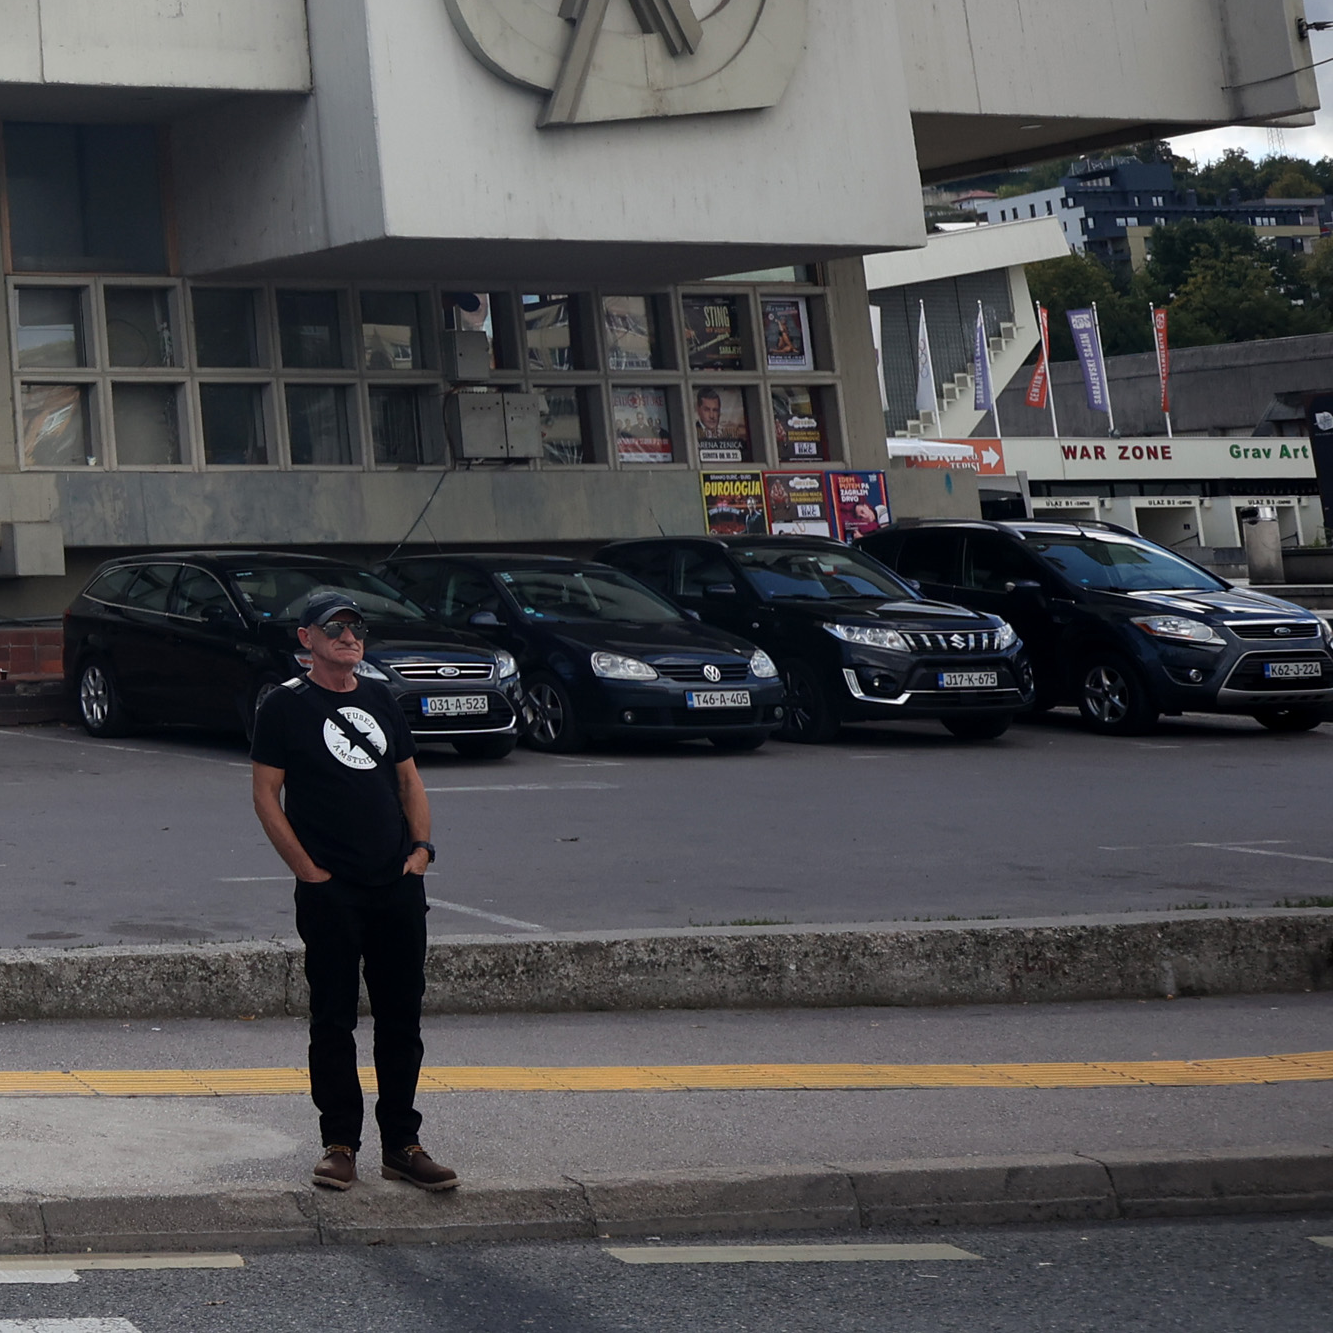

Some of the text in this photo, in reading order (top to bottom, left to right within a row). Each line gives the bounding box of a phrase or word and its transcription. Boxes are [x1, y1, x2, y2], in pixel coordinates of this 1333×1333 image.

[703, 306, 731, 328] STING
[1086, 358, 1103, 405] SARAJEVSKI
[1061, 445, 1173, 461] WAR ZONE
[1229, 444, 1310, 459] Grav Art
[841, 495, 859, 503] DRVO
[1270, 664, 1320, 676] K62-J-224
[945, 673, 997, 686] J17-K-675
[695, 692, 749, 706] T46-A-405
